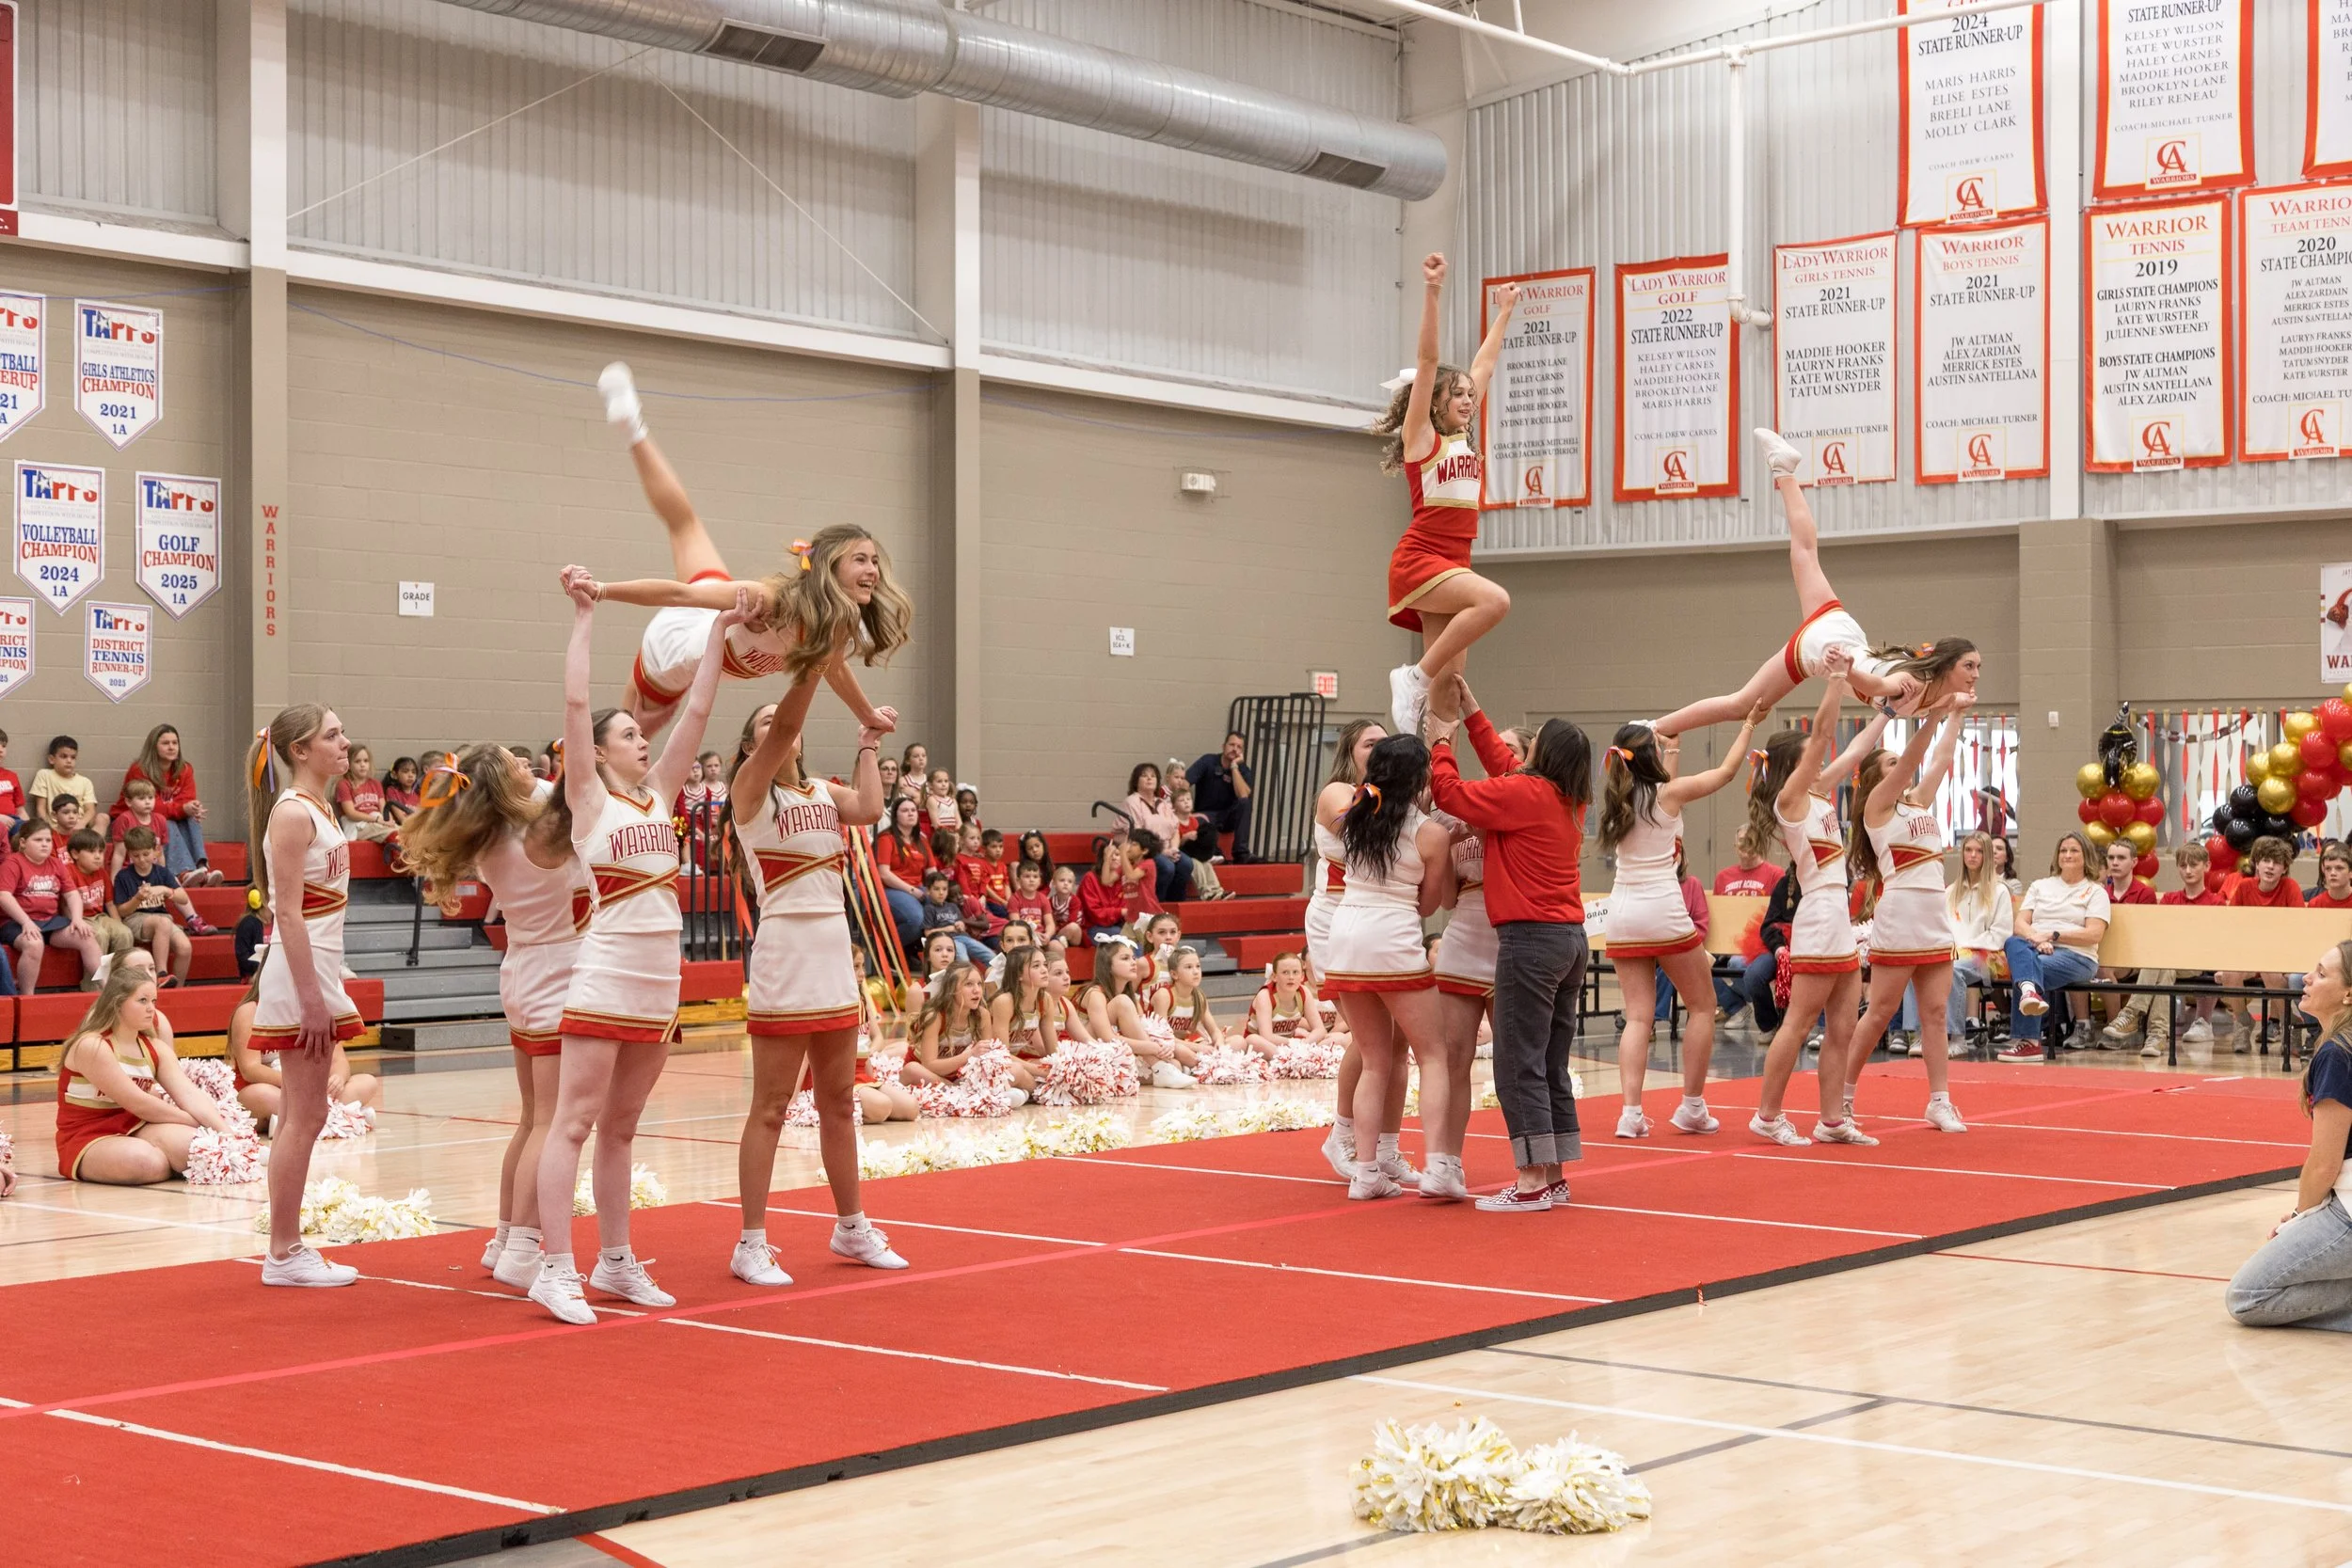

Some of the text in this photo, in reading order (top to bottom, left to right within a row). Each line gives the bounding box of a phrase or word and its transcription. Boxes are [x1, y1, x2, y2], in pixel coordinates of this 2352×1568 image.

[1951, 12, 1989, 33] 2024
[2128, 8, 2160, 24] STATE
[1918, 24, 2023, 56] STATE RUNNER-UP
[2124, 20, 2224, 42] KELSEY WILSON
[2125, 35, 2222, 55] KATE WURSTER
[2126, 48, 2221, 69] HALEY CARNES
[1925, 66, 2016, 91] MARIS HARRIS
[2119, 60, 2229, 84] MADDIE HOOKER
[2121, 75, 2227, 96] BROOKLYN LANE
[1932, 84, 2009, 106] ELISE ESTES
[2129, 89, 2218, 109] RILEY RENEAU
[1979, 100, 2011, 115] LANE
[1925, 114, 2016, 140] MOLLY CLARK
[2106, 215, 2208, 240] WARRIOR
[2271, 220, 2310, 233] TEAM
[1942, 236, 2025, 255] WARRIOR
[2129, 239, 2185, 256] TENNIS
[2297, 236, 2336, 253] 2020
[1783, 246, 1888, 271] LADY WARRIOR
[1943, 254, 2020, 272] BOYS TENNIS
[2261, 256, 2297, 272] STATE
[1794, 266, 1875, 284] GIRLS TENNIS
[2135, 259, 2179, 277] 2019
[1631, 271, 1725, 293] LADY WARRIOR
[1965, 274, 1999, 290] 2021
[2097, 278, 2218, 301] GIRLS STATE CHAMPIONS
[1527, 284, 1584, 299] WARRIOR
[1658, 290, 1699, 305] GOLF
[1820, 286, 1851, 301] 2021
[1930, 285, 2036, 307] STATE RUNNER-UP
[1523, 304, 1551, 315] GOLF
[1785, 297, 1885, 319] STATE RUNNER-UP
[2114, 295, 2201, 313] LAURYN FRANKS
[1661, 308, 1693, 324] 2022
[2117, 309, 2199, 326] KATE WURSTER
[1523, 320, 1551, 334] 2021
[1630, 322, 1724, 344] STATE RUNNER-UP
[2159, 321, 2210, 336] SWEENEY
[1501, 331, 1577, 350] TATE RUNNER-UP
[1951, 332, 2013, 348] JW ALTMAN
[1637, 347, 1717, 362] KELSEY WILSON
[1785, 341, 1886, 360] MADDIE HOOKER
[1944, 349, 1970, 360] ALEX
[2099, 346, 2216, 368] BOYS STATE CHAMPIONS
[1640, 360, 1714, 374] HALEY CARNES
[1787, 354, 1883, 372] LAURYN FRANKS
[1942, 356, 2023, 373] MERRICK ESTES
[82, 362, 155, 384] GIRLS ATHLETICS
[1633, 372, 1721, 387] MADDIE HOOKER
[1789, 367, 1881, 386] KATE WURSTER
[1927, 368, 2037, 388] AUSTIN SANTELLANA
[2124, 365, 2187, 381] JW ALTMAN
[82, 377, 155, 401] CHAMPION
[1692, 384, 1718, 394] LANE
[1789, 380, 1882, 398] TATUM SNYDER
[2102, 376, 2213, 395] AUSTIN SANTELLANA
[1642, 396, 1712, 410] MARIS HARRIS
[2118, 391, 2197, 406] ALEX ZARDAIN
[100, 403, 136, 420] 2021
[2002, 414, 2038, 424] TURNER
[112, 423, 127, 436] 1A
[1854, 424, 1888, 435] TURNER
[22, 524, 97, 545] VOLLEYBALL
[158, 534, 200, 553] GOLF
[21, 541, 97, 564] CHAMPION
[143, 550, 215, 573] CHAMPION
[40, 564, 79, 582] 2024
[261, 504, 280, 637] WARRIORS
[161, 573, 198, 590] 2025
[53, 585, 69, 597] 1A
[172, 593, 187, 605] 1A
[402, 592, 430, 601] GRADE
[92, 638, 145, 652] DISTRICT
[92, 650, 145, 664] TENNIS
[91, 661, 145, 676] RUNNER-UP
[108, 678, 127, 688] 2025
